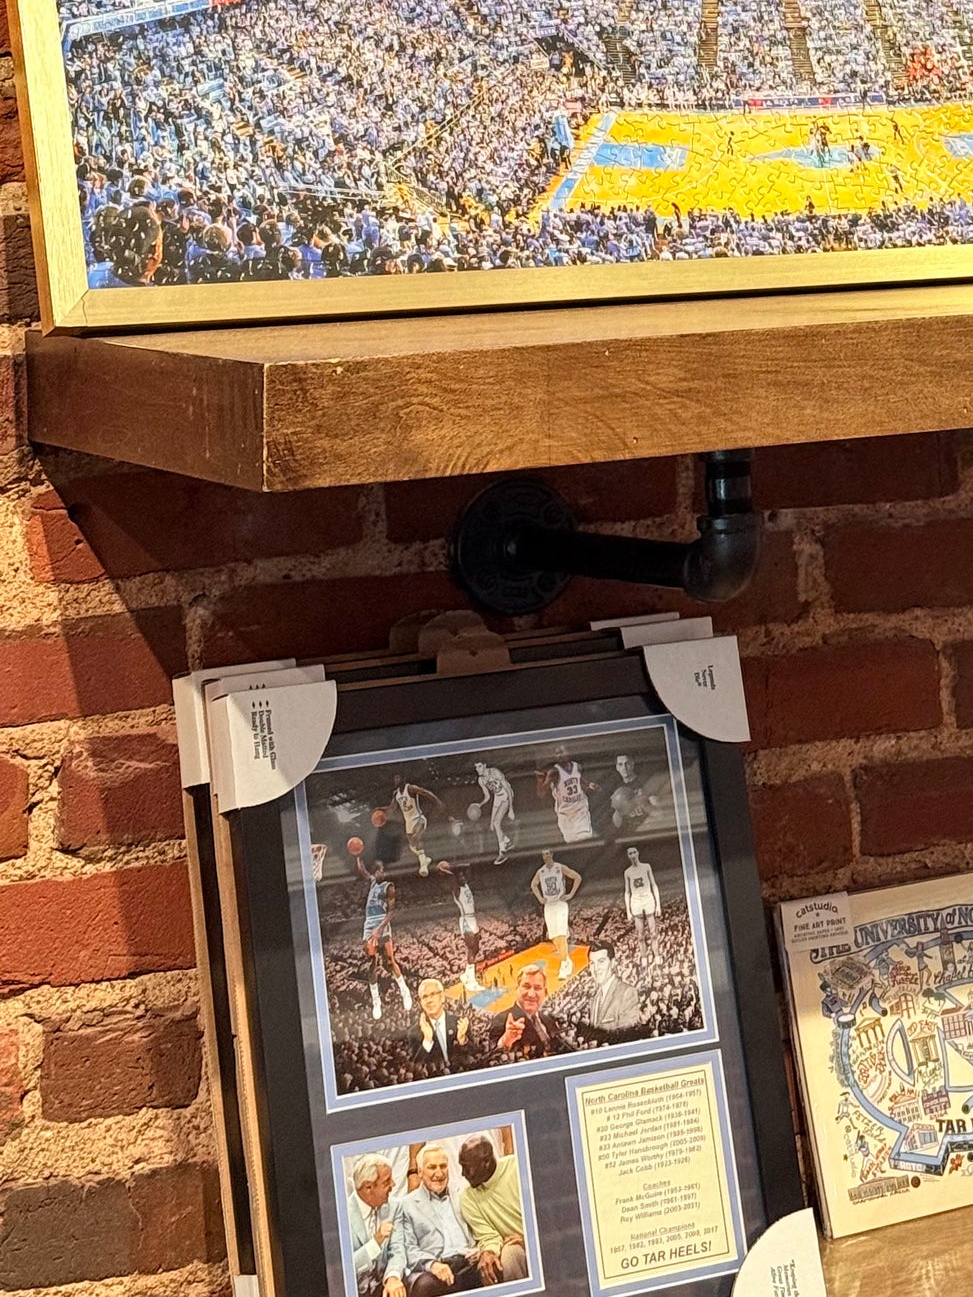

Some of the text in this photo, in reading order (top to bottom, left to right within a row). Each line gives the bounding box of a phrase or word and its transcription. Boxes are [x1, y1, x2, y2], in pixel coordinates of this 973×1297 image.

[250, 711, 258, 732] Ready
[258, 710, 267, 733] Double
[265, 709, 278, 770] Framed with Glass
[566, 785, 579, 796] 33
[796, 902, 839, 919] catstudio
[794, 917, 846, 932] FINE ART PRINT
[854, 912, 940, 948] UNIVERSITY
[945, 910, 957, 925] of
[585, 1077, 704, 1105] North Carolina Basketball Greats
[622, 1110, 635, 1118] Phil
[636, 1108, 651, 1117] Ford
[610, 1120, 634, 1132] George
[936, 1118, 967, 1134] TAR
[613, 1128, 638, 1140] Michael
[611, 1149, 627, 1160] Tyler
[618, 1167, 633, 1176] Jack
[643, 1180, 671, 1191] Coaches
[615, 1196, 634, 1205] Frank
[640, 1200, 659, 1210] Smith
[621, 1240, 712, 1270] GO TAR HEELS!
